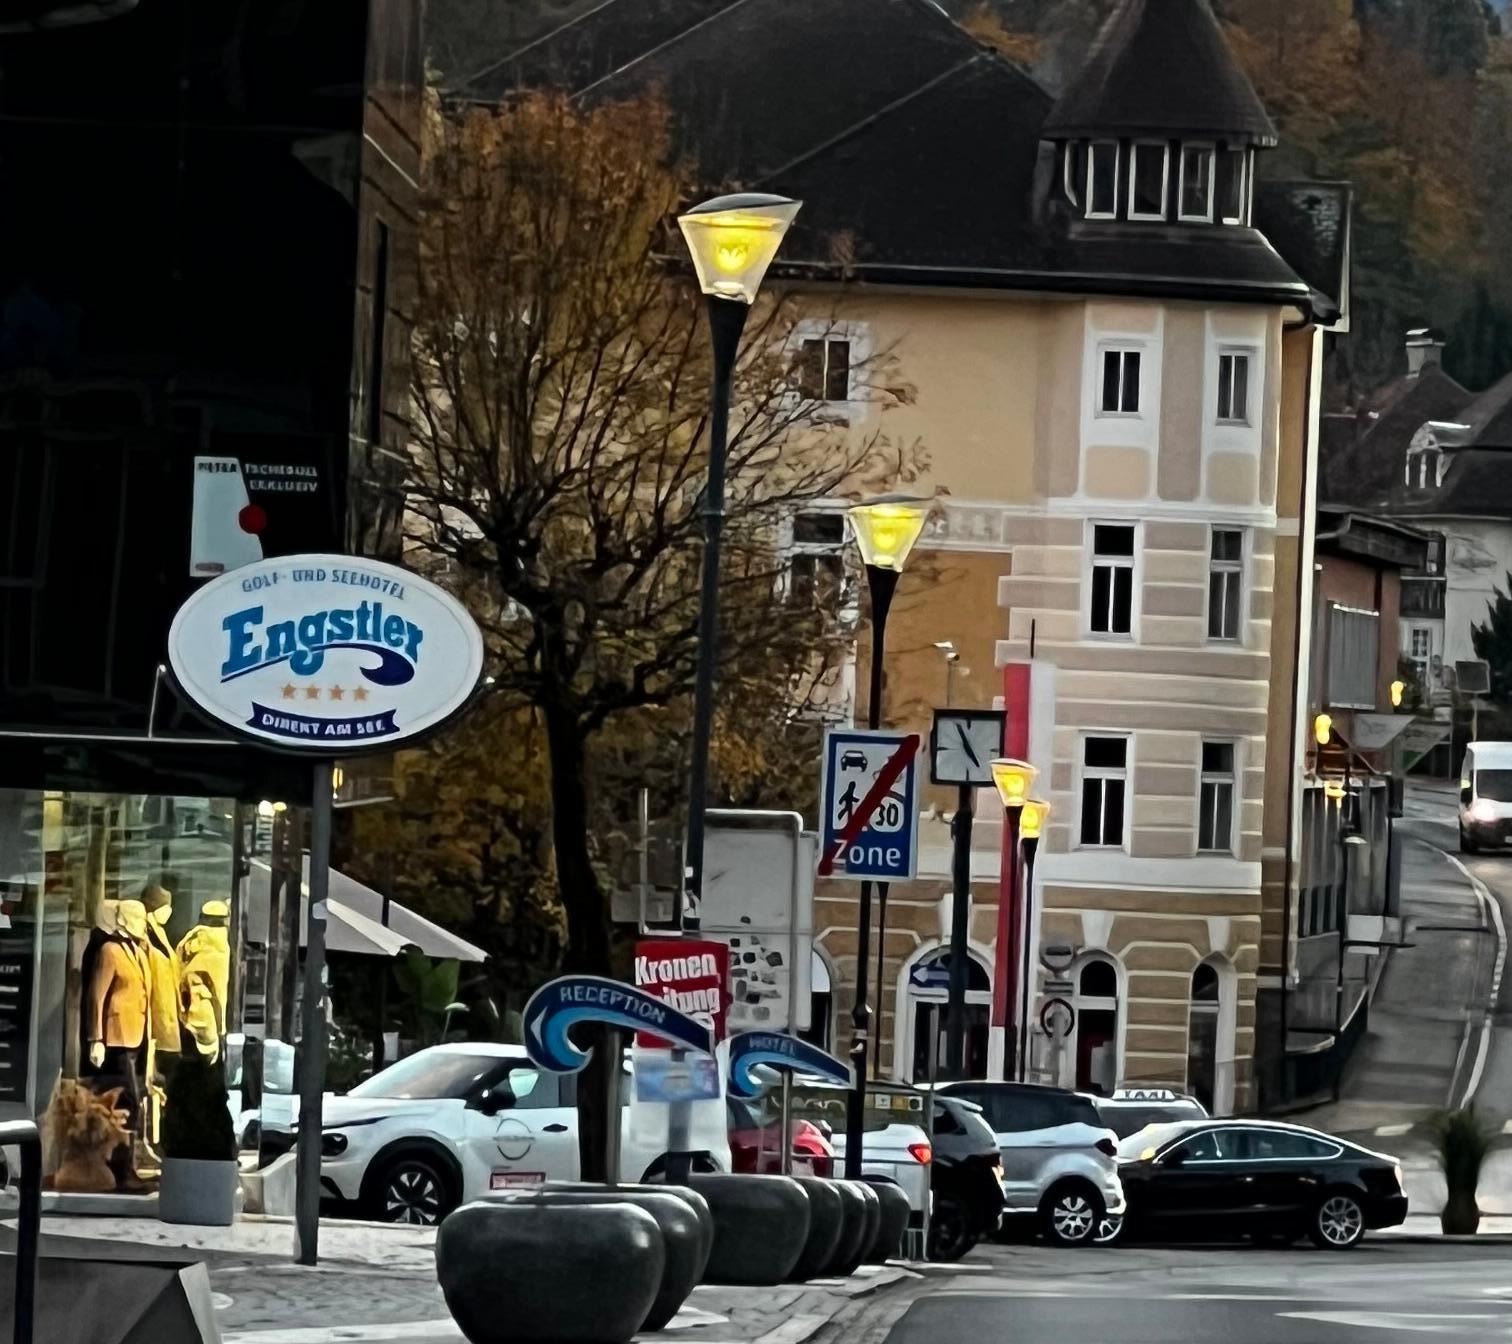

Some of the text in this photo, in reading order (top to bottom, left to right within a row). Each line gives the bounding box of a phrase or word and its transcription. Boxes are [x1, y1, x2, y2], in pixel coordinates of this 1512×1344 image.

[292, 568, 326, 582] UND
[332, 570, 405, 600] SEEHOTEL
[221, 600, 424, 676] Engstler
[261, 713, 320, 734] DIREKT
[324, 720, 352, 735] AM
[875, 803, 899, 827] 30
[832, 839, 901, 867] Zone
[635, 954, 719, 985] Kronen
[560, 985, 666, 1024] RECEPTION
[656, 987, 720, 1014] itung
